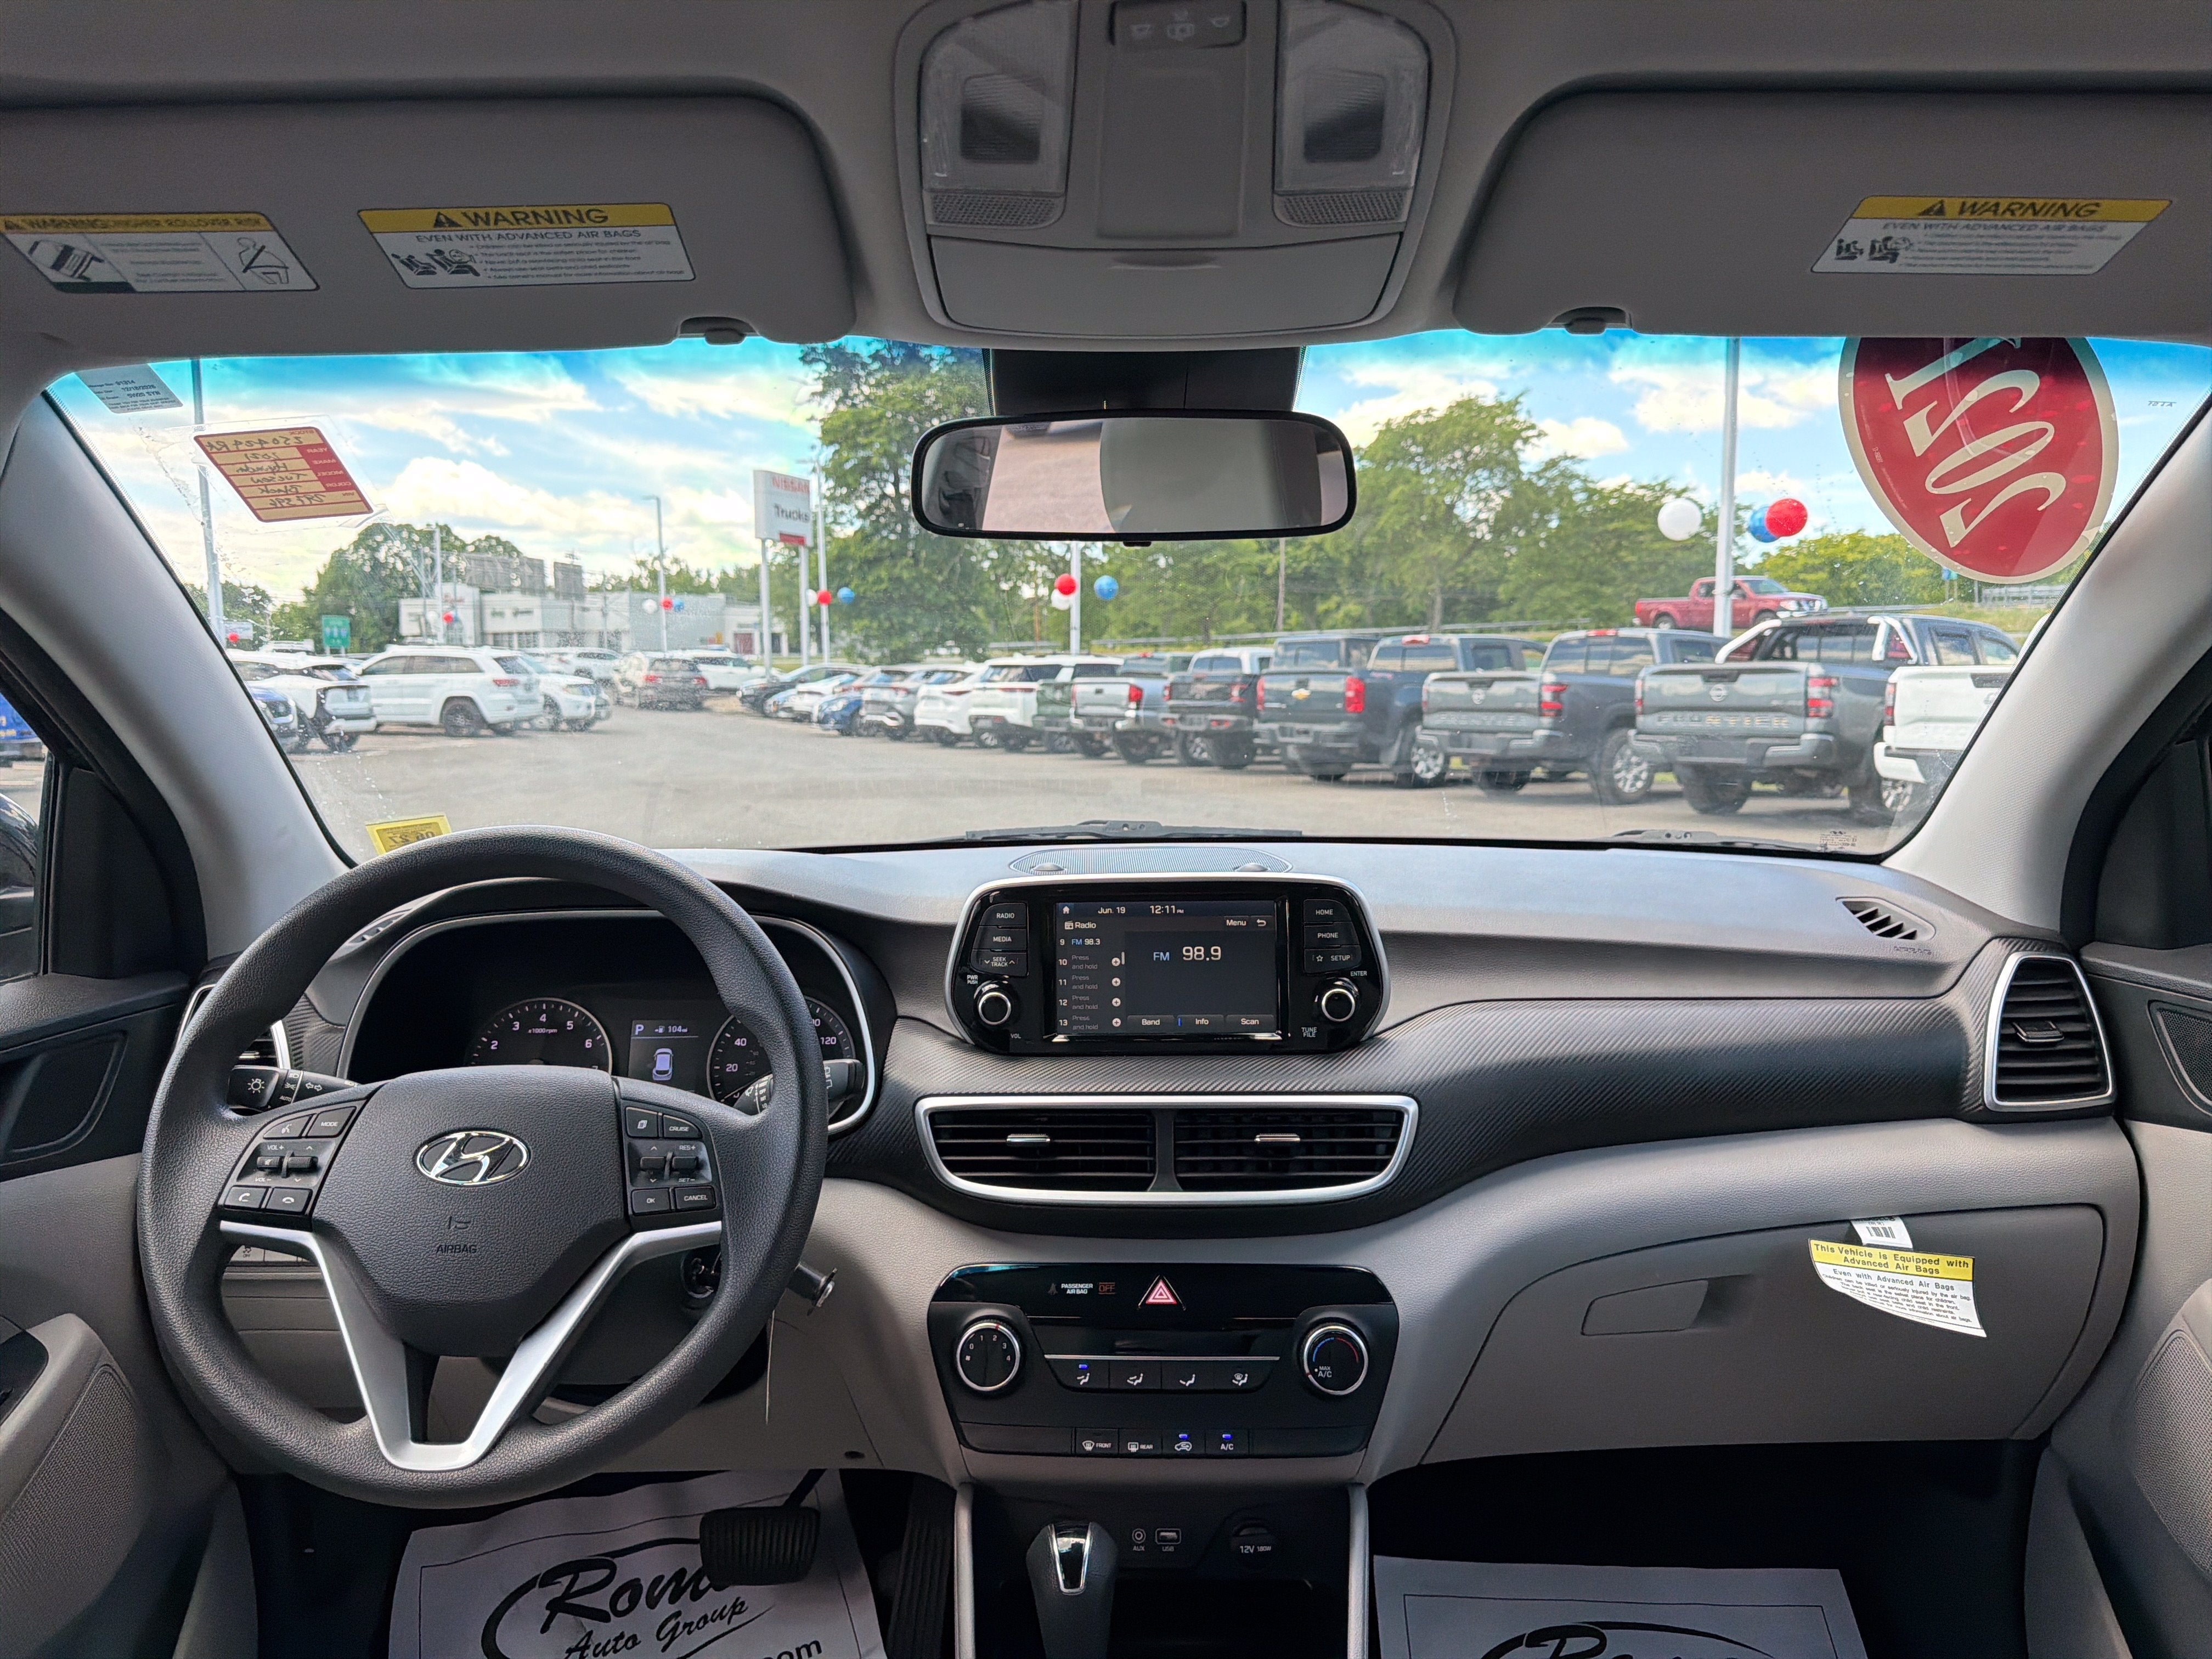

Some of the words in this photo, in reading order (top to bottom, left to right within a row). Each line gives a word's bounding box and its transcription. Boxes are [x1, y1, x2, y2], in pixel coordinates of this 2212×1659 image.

[1958, 201, 2101, 218] WARNING
[463, 208, 608, 227] WARNING
[416, 233, 453, 242] EVEN
[456, 233, 493, 242] WITH
[497, 231, 572, 241] ADVANCED
[577, 230, 599, 239] AIR
[604, 229, 641, 238] BAGS
[774, 504, 810, 522] Trucks
[1153, 952, 1170, 961] FM
[1182, 946, 1222, 961] 98.9
[539, 1013, 547, 1023] 4
[511, 1020, 520, 1031] 3
[566, 1020, 574, 1030] 5
[634, 1024, 645, 1035] P
[490, 1040, 498, 1051] 2
[585, 1039, 592, 1049] 6
[734, 1037, 747, 1047] 40
[820, 1036, 837, 1045] 120
[725, 1063, 738, 1073] 20
[436, 1244, 478, 1255] AIRBAG
[1814, 1243, 1835, 1253] This
[1838, 1246, 1873, 1258] Vehicle
[1893, 1254, 1940, 1265] Equipped
[1946, 1259, 1969, 1268] with
[1843, 1256, 1889, 1269] Advanced
[1895, 1262, 1909, 1271] Air
[1915, 1265, 1940, 1274] Bags
[1833, 1268, 1852, 1277] Even
[1877, 1275, 1914, 1286] Advanced
[1934, 1282, 1955, 1291] Bags
[1099, 1284, 1115, 1293] OFF
[1239, 1545, 1255, 1554] 12V
[537, 1556, 731, 1634] Rom
[565, 1630, 642, 1659] Auto
[655, 1595, 749, 1654] Group
